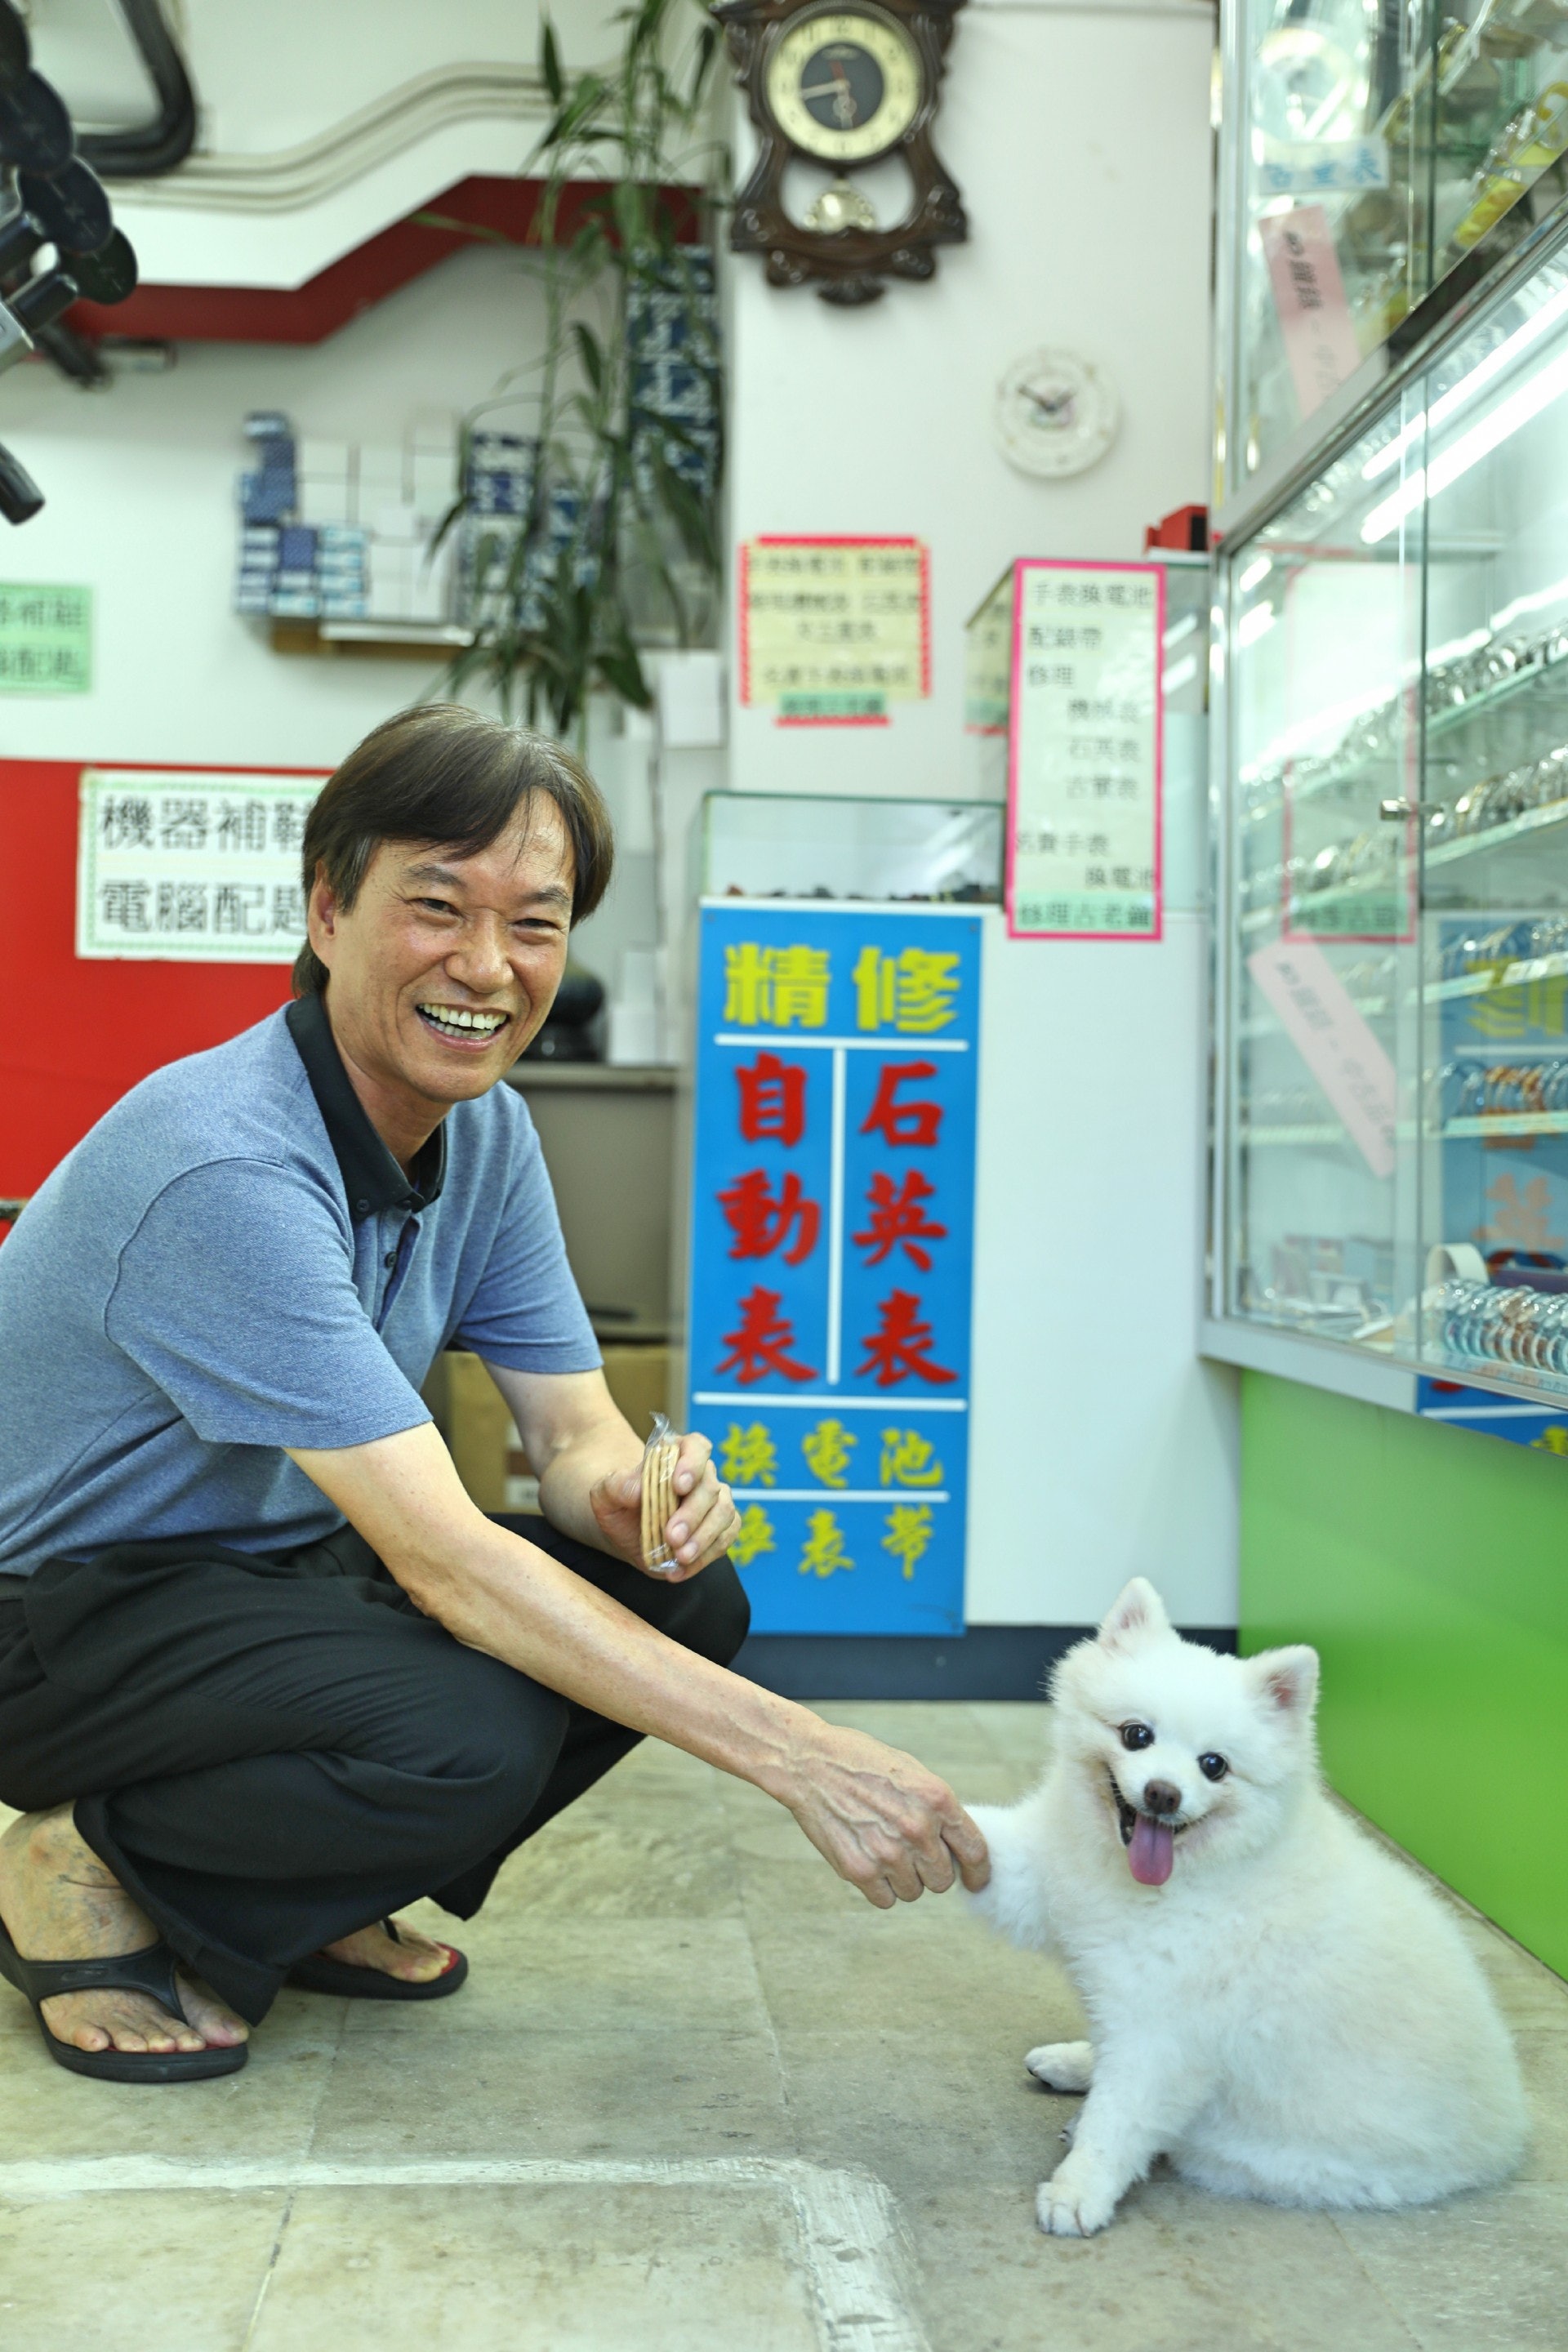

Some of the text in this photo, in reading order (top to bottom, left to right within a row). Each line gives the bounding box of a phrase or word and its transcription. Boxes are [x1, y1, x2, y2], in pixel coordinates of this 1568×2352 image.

[1027, 665, 1076, 688] 修理
[724, 942, 961, 1032] 精修
[713, 1050, 822, 1385] 自動表
[851, 1059, 960, 1388] 石英表
[719, 1419, 944, 1489] 換電池
